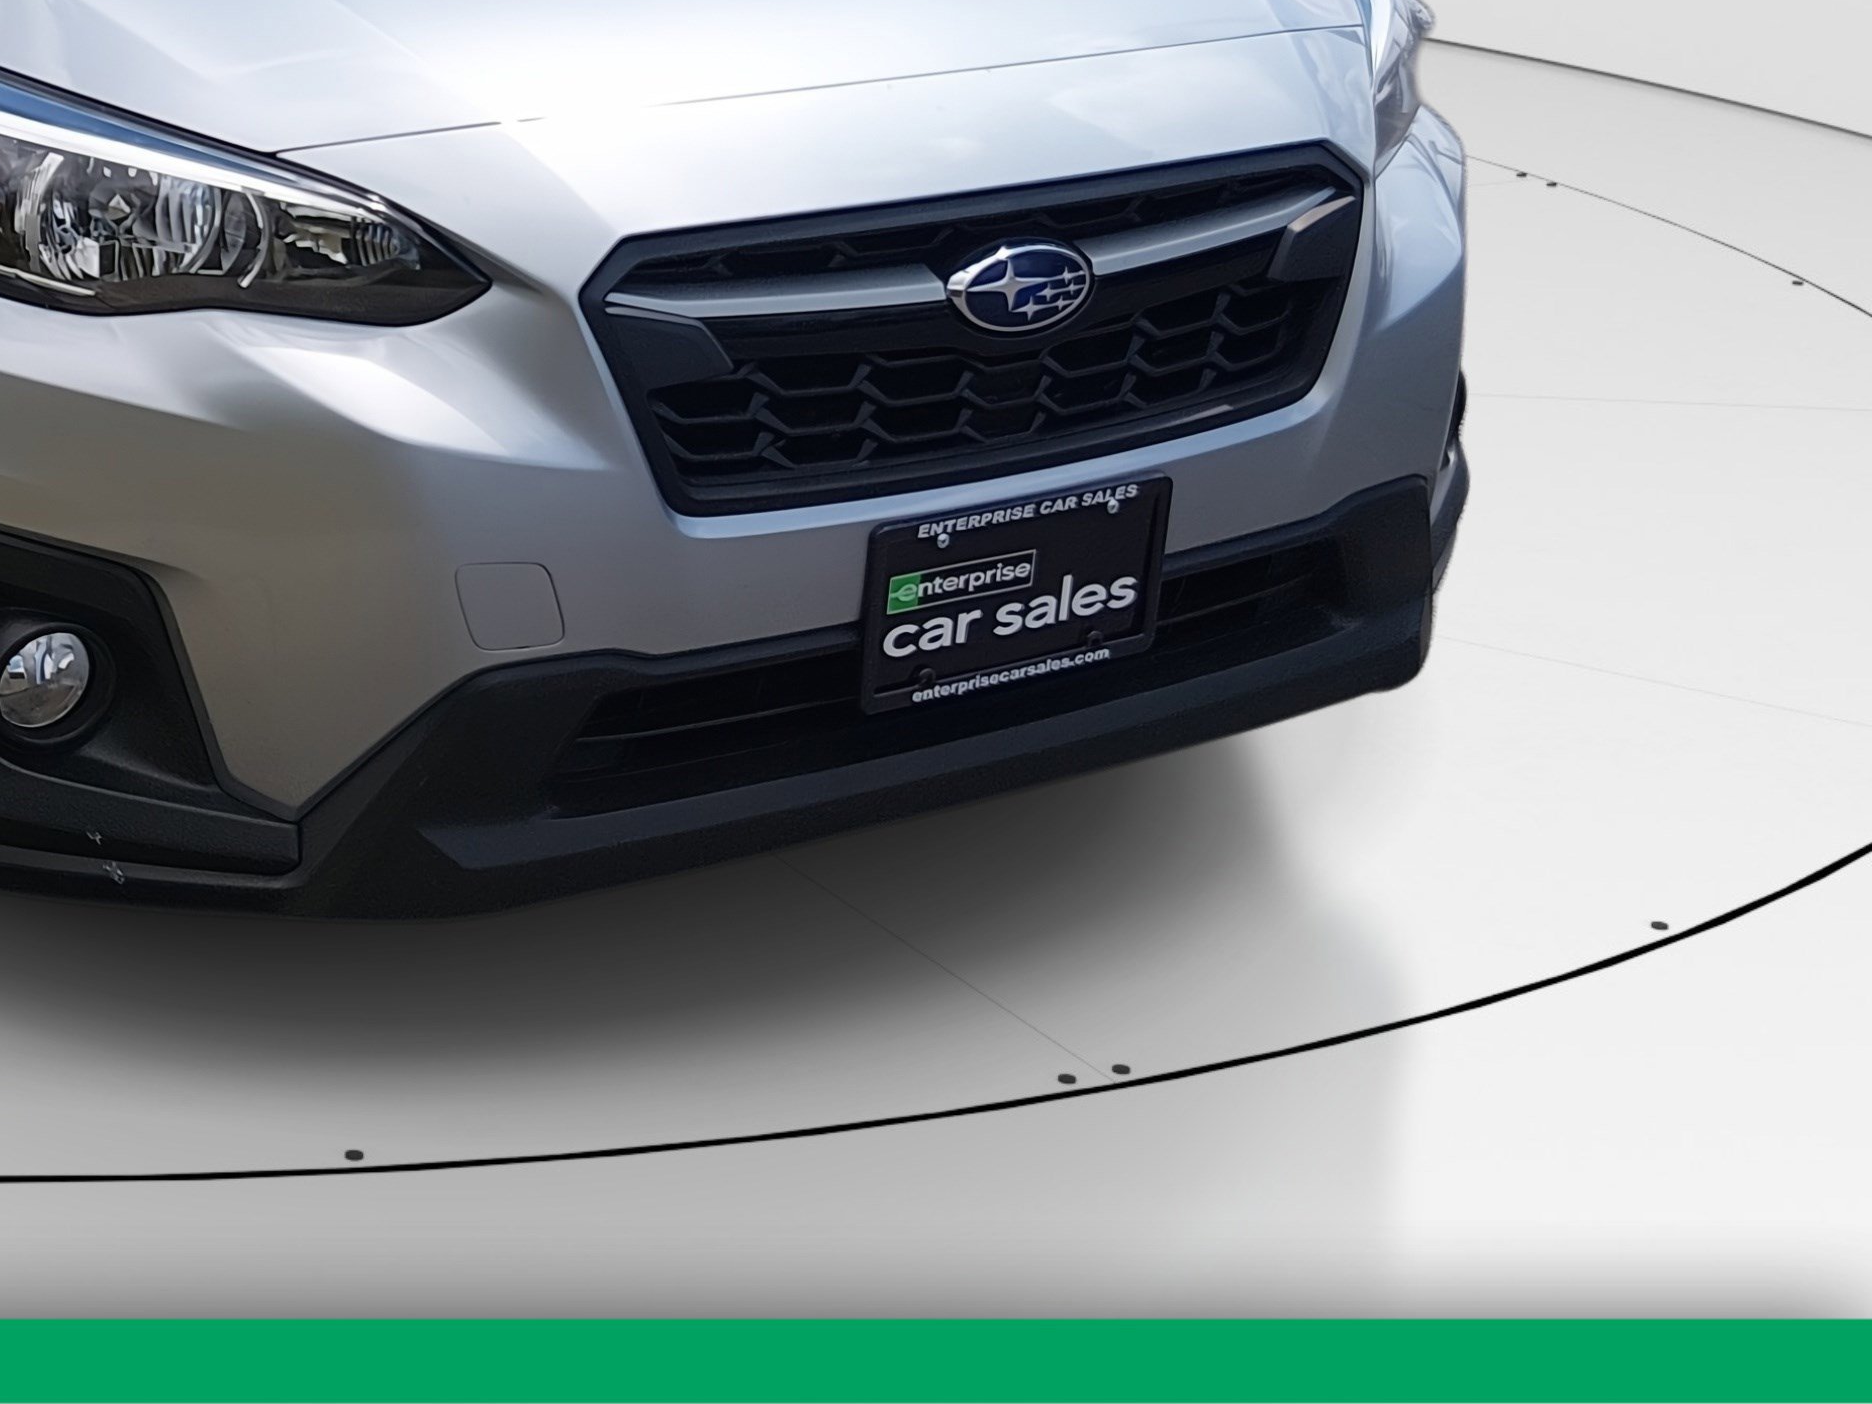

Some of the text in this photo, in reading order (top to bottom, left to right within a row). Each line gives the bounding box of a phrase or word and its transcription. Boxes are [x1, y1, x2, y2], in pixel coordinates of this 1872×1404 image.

[917, 484, 1138, 538] ENTERPRISE CAR SALES
[894, 562, 1032, 601] enterprise
[883, 574, 1138, 658] car sales
[912, 648, 1111, 703] enterprisecarsales.com
